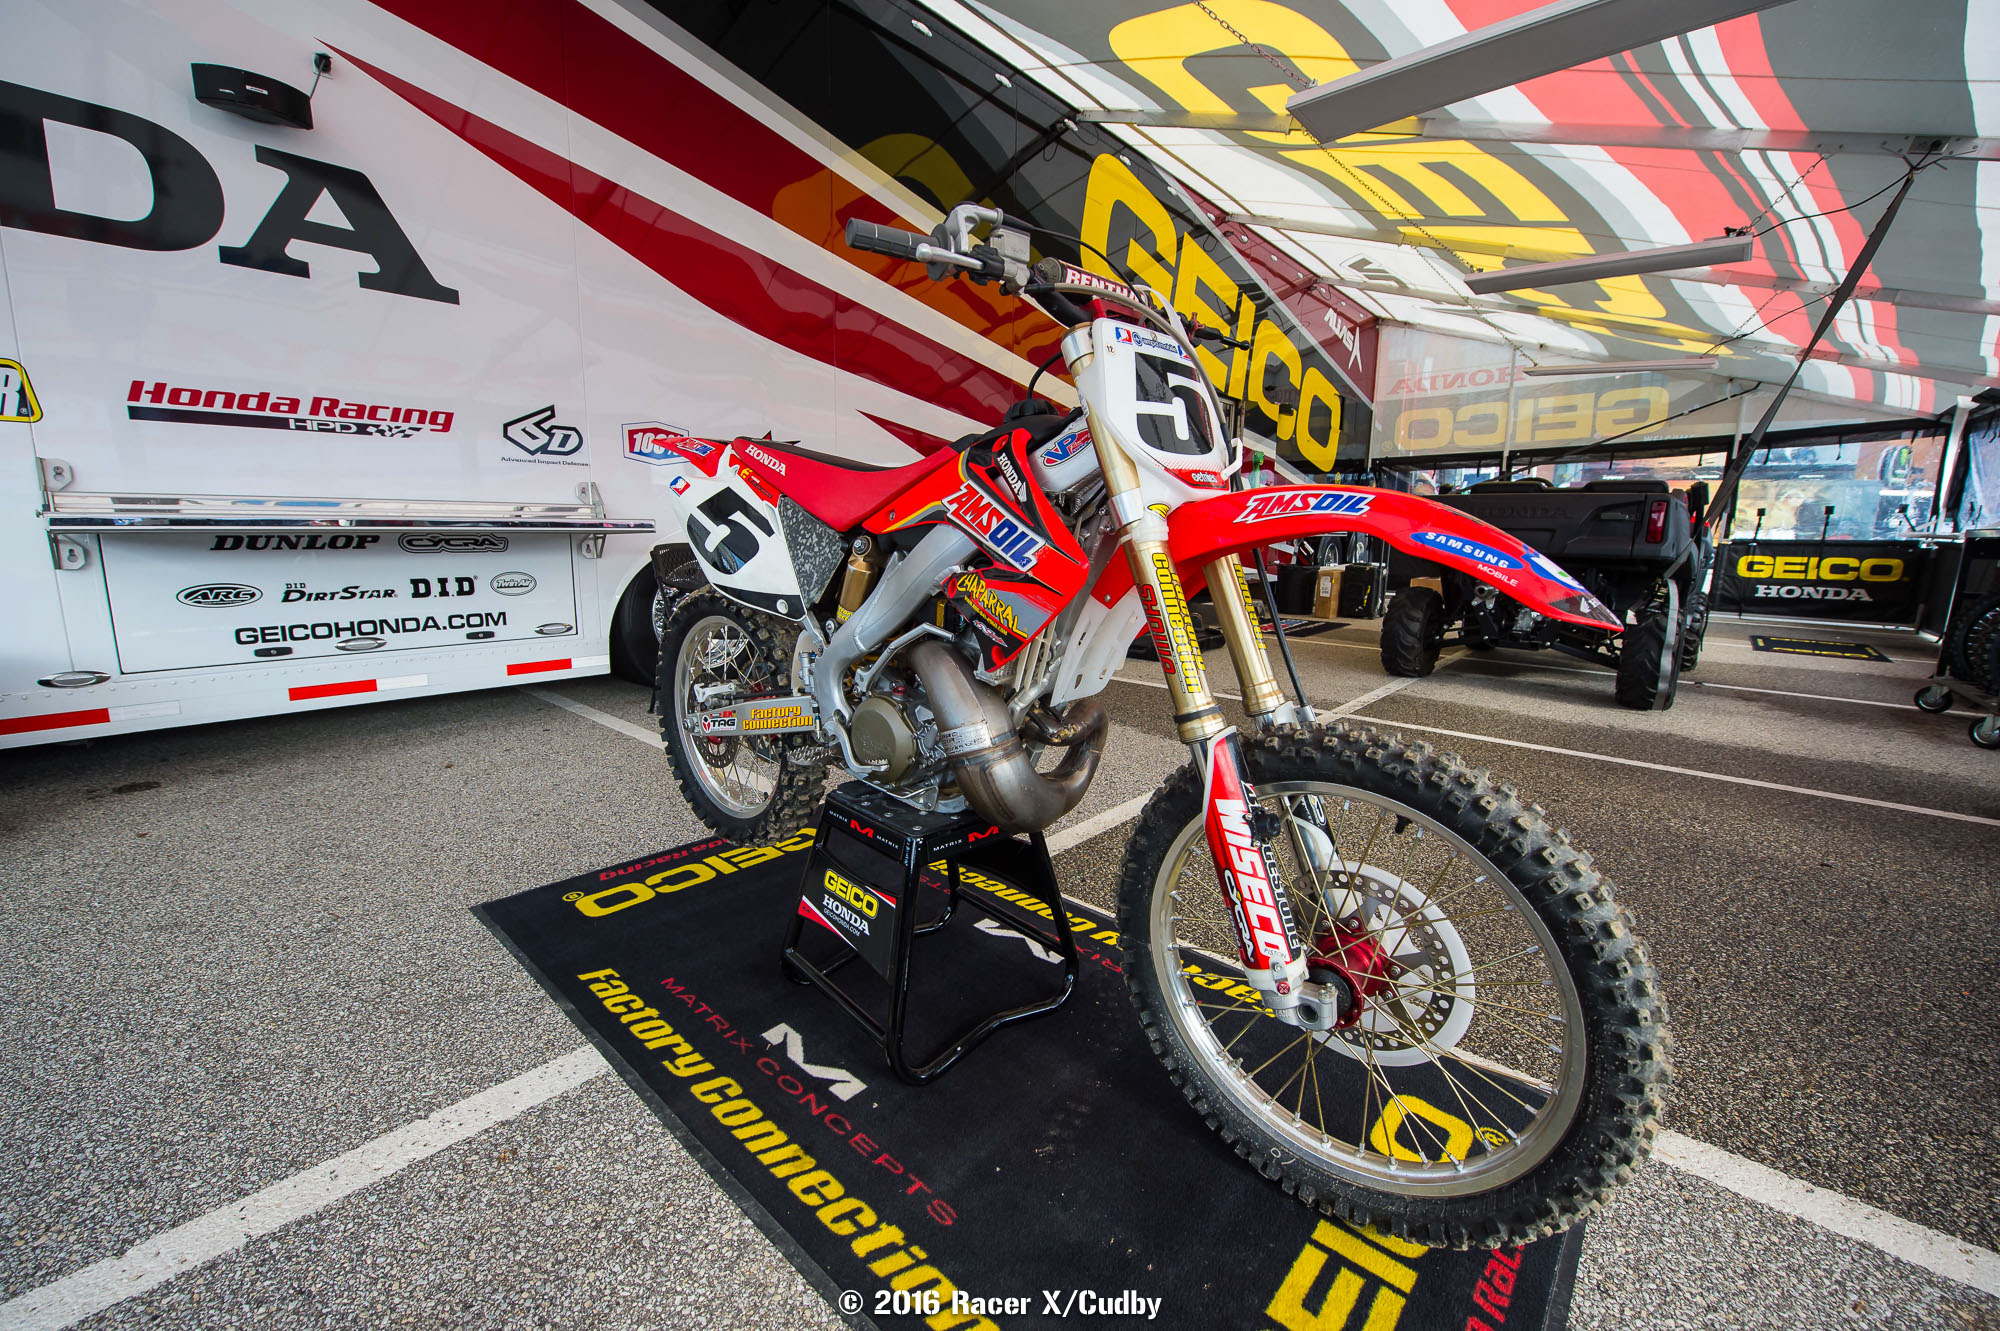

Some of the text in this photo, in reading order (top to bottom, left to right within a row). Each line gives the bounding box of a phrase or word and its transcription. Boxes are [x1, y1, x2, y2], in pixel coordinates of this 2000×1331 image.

[1080, 153, 1341, 472] GEICO
[127, 380, 455, 433] Honda Racing
[1133, 351, 1214, 456] 5
[288, 418, 359, 434] HPD
[745, 444, 786, 477] HONDA
[1043, 432, 1077, 461] VP
[997, 452, 1023, 496] HONDA
[944, 481, 1043, 570] AMSOIL
[1234, 490, 1377, 524] AMSOIL
[210, 534, 380, 551] DUNLOP
[686, 486, 775, 577] 5
[1424, 531, 1510, 569] SAMSUNG
[1477, 563, 1520, 588] MOBILE
[1737, 555, 1904, 582] GEICO
[957, 573, 1028, 638] CHAPARRAL
[1754, 585, 1873, 601] HONDA
[234, 611, 508, 645] GEICOHONDA.COM
[711, 718, 736, 727] TAG
[742, 715, 813, 731] Connection
[750, 705, 801, 719] Factory
[829, 810, 848, 823] MATRIX
[876, 835, 900, 849] MATRIX
[933, 839, 963, 852] MATRIX
[824, 868, 879, 919] GEICO
[1214, 798, 1292, 963] WISECO
[822, 894, 870, 935] HONDA
[1223, 868, 1254, 962] CYCRA
[661, 977, 958, 1226] MATRIX CONCEPTS
[578, 967, 1000, 1331] Factory Connection
